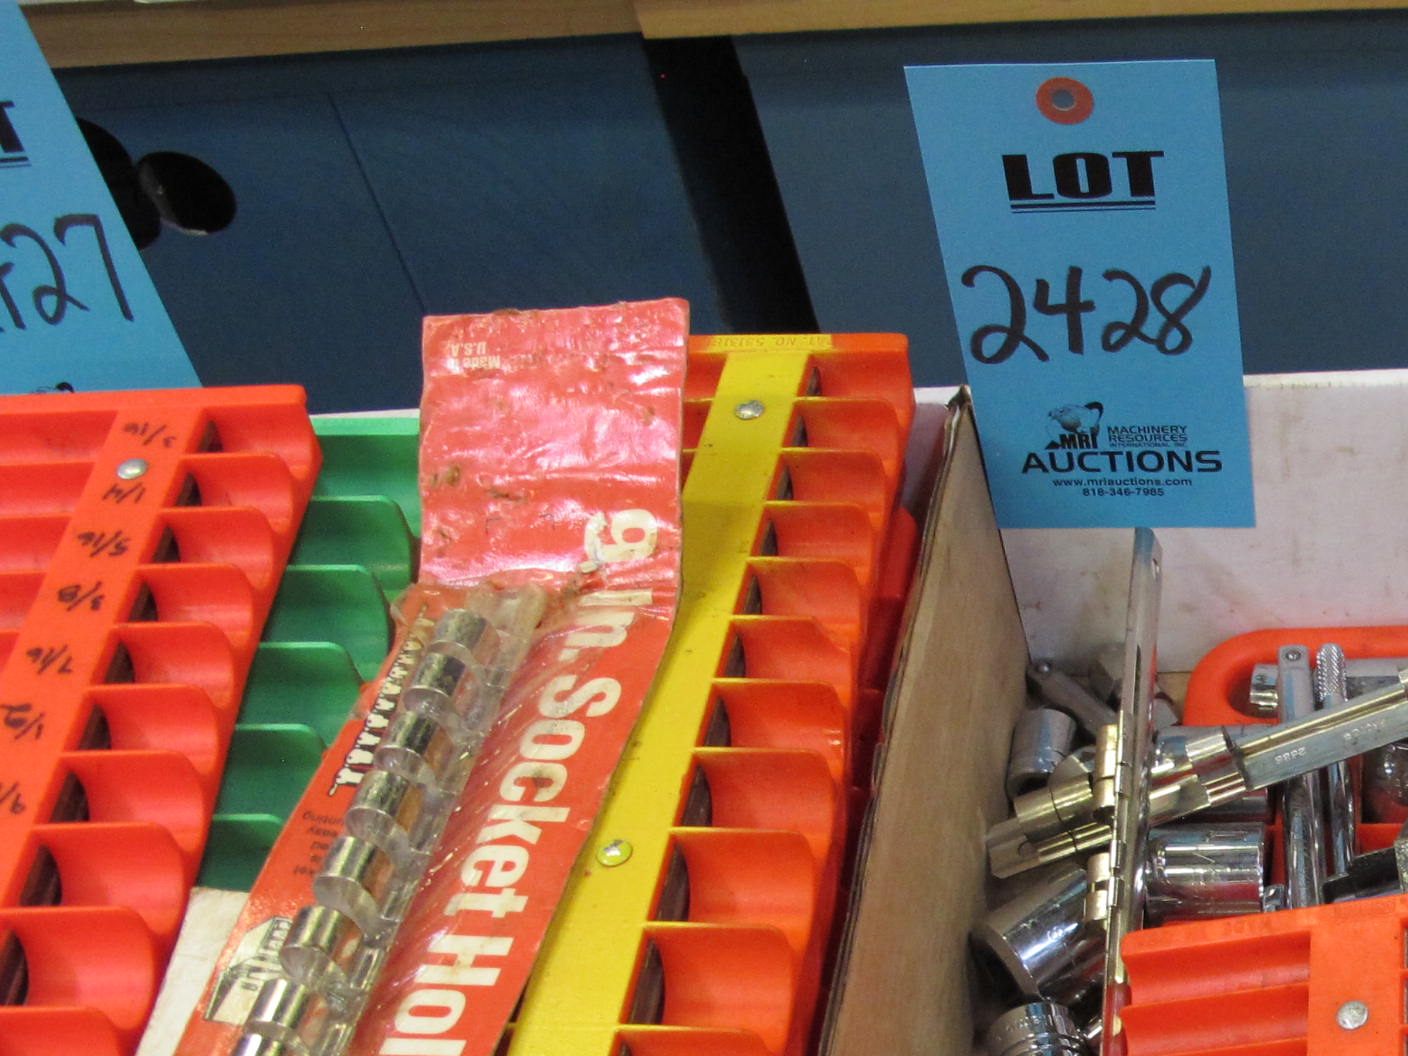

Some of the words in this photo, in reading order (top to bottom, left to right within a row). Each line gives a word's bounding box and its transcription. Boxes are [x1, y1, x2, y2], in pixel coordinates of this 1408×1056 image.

[1002, 151, 1164, 200] LOT
[961, 264, 1211, 364] 2428
[463, 354, 501, 371] Made
[1107, 425, 1188, 434] MACHINERY
[1108, 433, 1188, 442] RESOURCES
[1060, 434, 1099, 450] MRI
[1021, 450, 1222, 474] AUCTIONS
[1052, 477, 1192, 487] www.mriauctions.com
[1082, 487, 1164, 496] 818-346-7985
[444, 674, 622, 918] Socket
